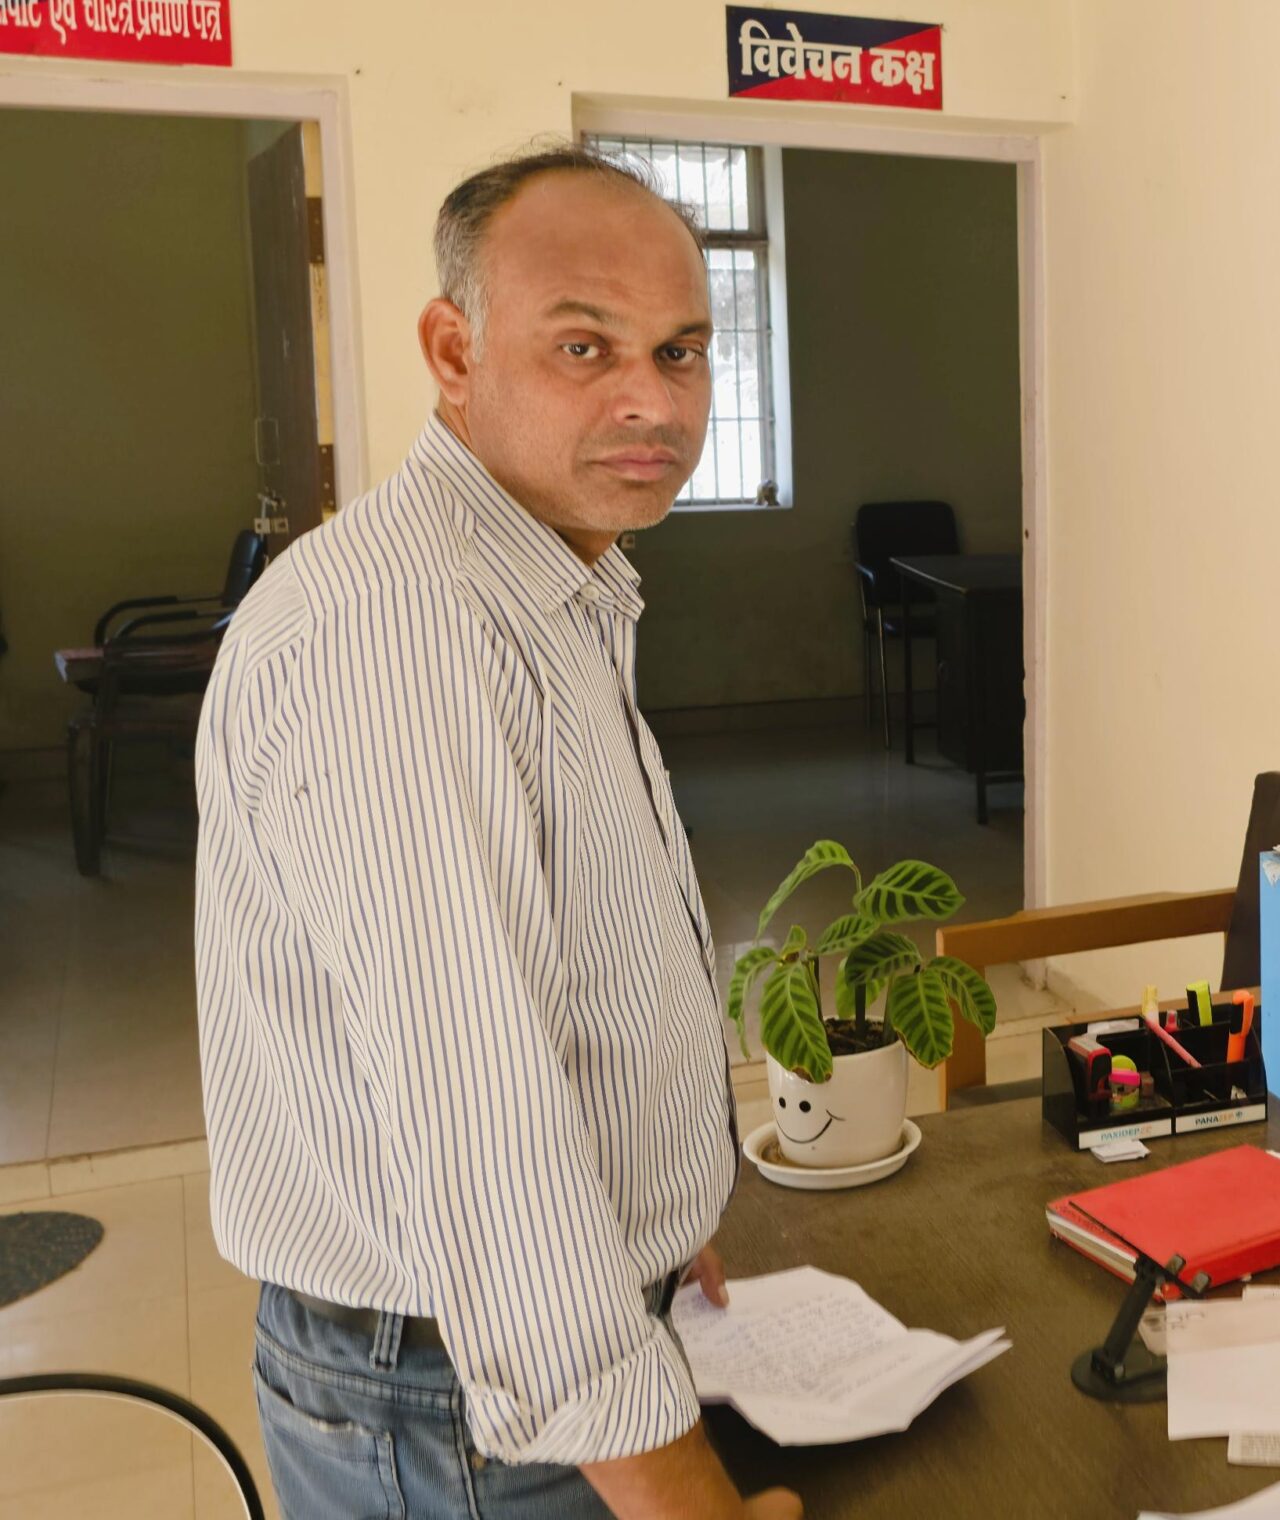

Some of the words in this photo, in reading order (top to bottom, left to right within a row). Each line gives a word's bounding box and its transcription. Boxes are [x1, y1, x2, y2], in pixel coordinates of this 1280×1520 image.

[191, 1, 222, 42] पत्र
[739, 19, 862, 84] विवेचन
[869, 47, 935, 94] कक्ष
